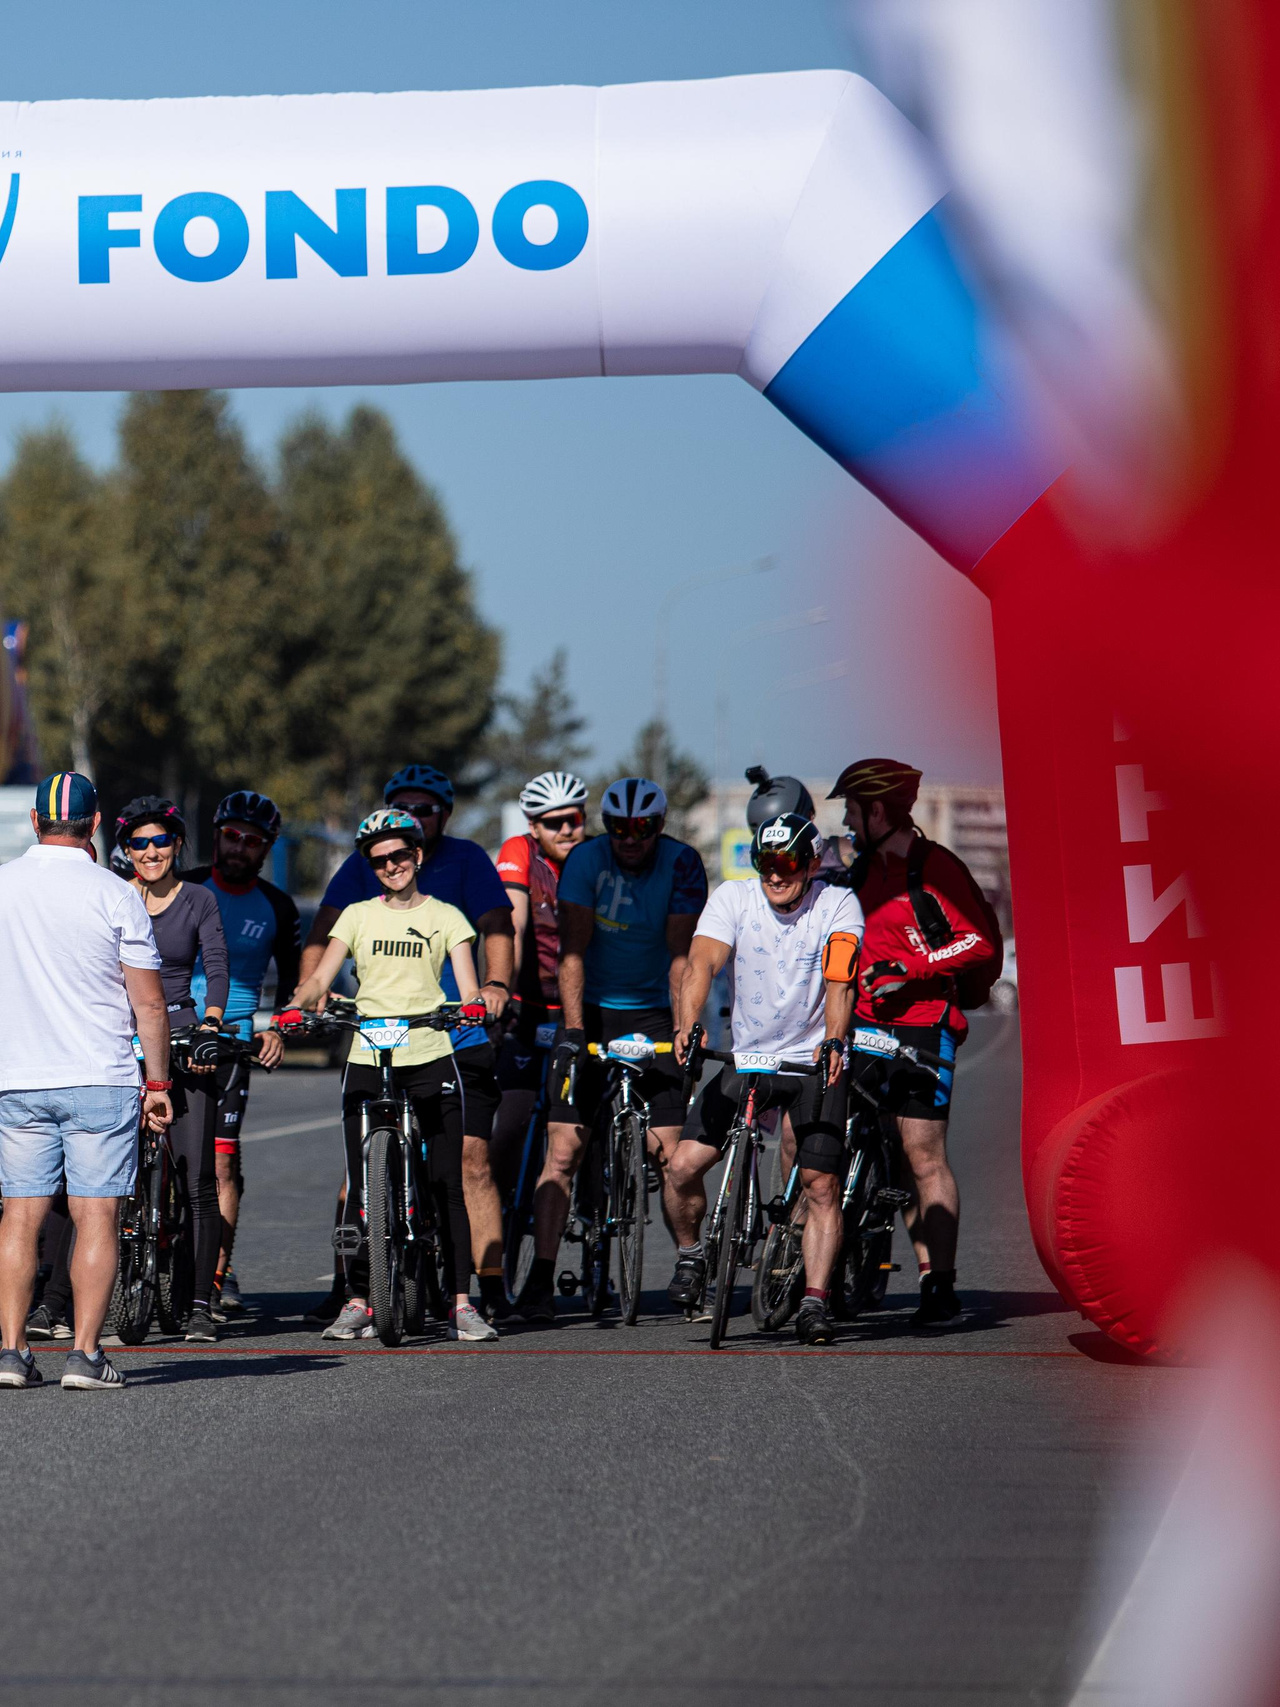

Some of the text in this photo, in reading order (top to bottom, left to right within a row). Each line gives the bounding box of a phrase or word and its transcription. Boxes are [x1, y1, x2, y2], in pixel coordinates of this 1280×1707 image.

[78, 180, 590, 285] FONDO
[765, 829, 785, 838] 210
[241, 919, 267, 939] Tri
[372, 940, 423, 958] PUMA
[365, 1029, 402, 1042] 3000
[860, 1034, 894, 1052] 3005
[614, 1043, 649, 1057] 3009
[740, 1054, 777, 1067] 3003
